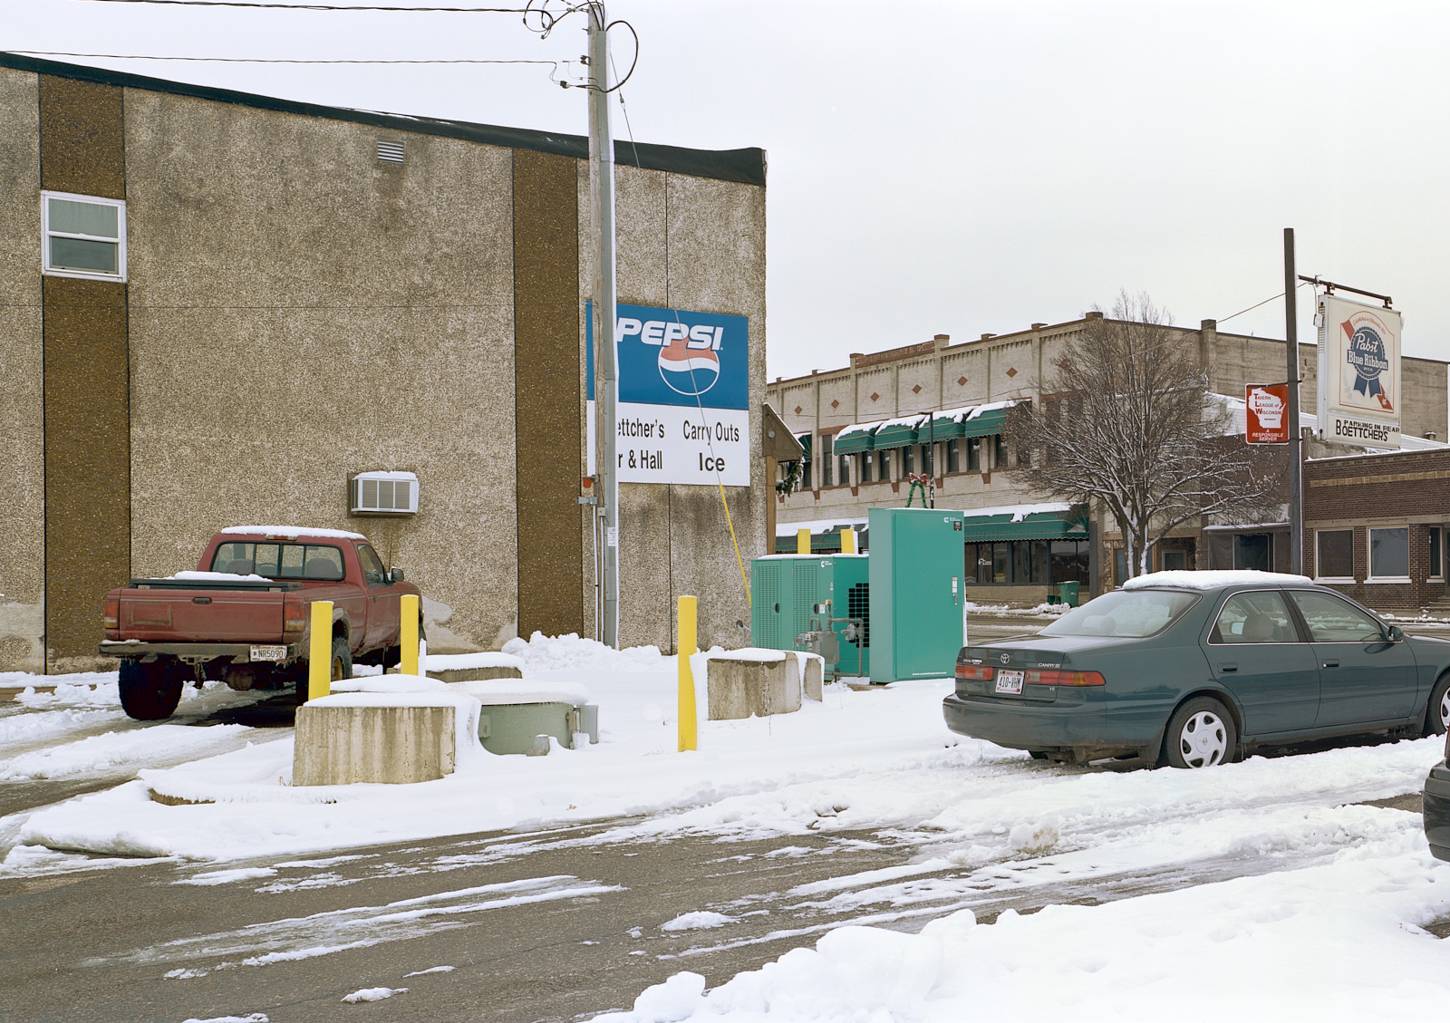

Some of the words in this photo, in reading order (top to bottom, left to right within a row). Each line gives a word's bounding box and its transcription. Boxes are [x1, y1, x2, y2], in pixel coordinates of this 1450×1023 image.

[617, 317, 723, 351] PEPSI
[1354, 333, 1379, 352] Pabst
[1348, 351, 1364, 366] Blue
[1364, 354, 1388, 369] Ribbon
[683, 420, 713, 445] Carry
[715, 423, 740, 442] Outs
[1336, 419, 1388, 442] BOETTCHERS
[1343, 419, 1373, 429] PARKING
[628, 449, 637, 469] &
[640, 450, 663, 470] Hall
[699, 452, 725, 472] Ice
